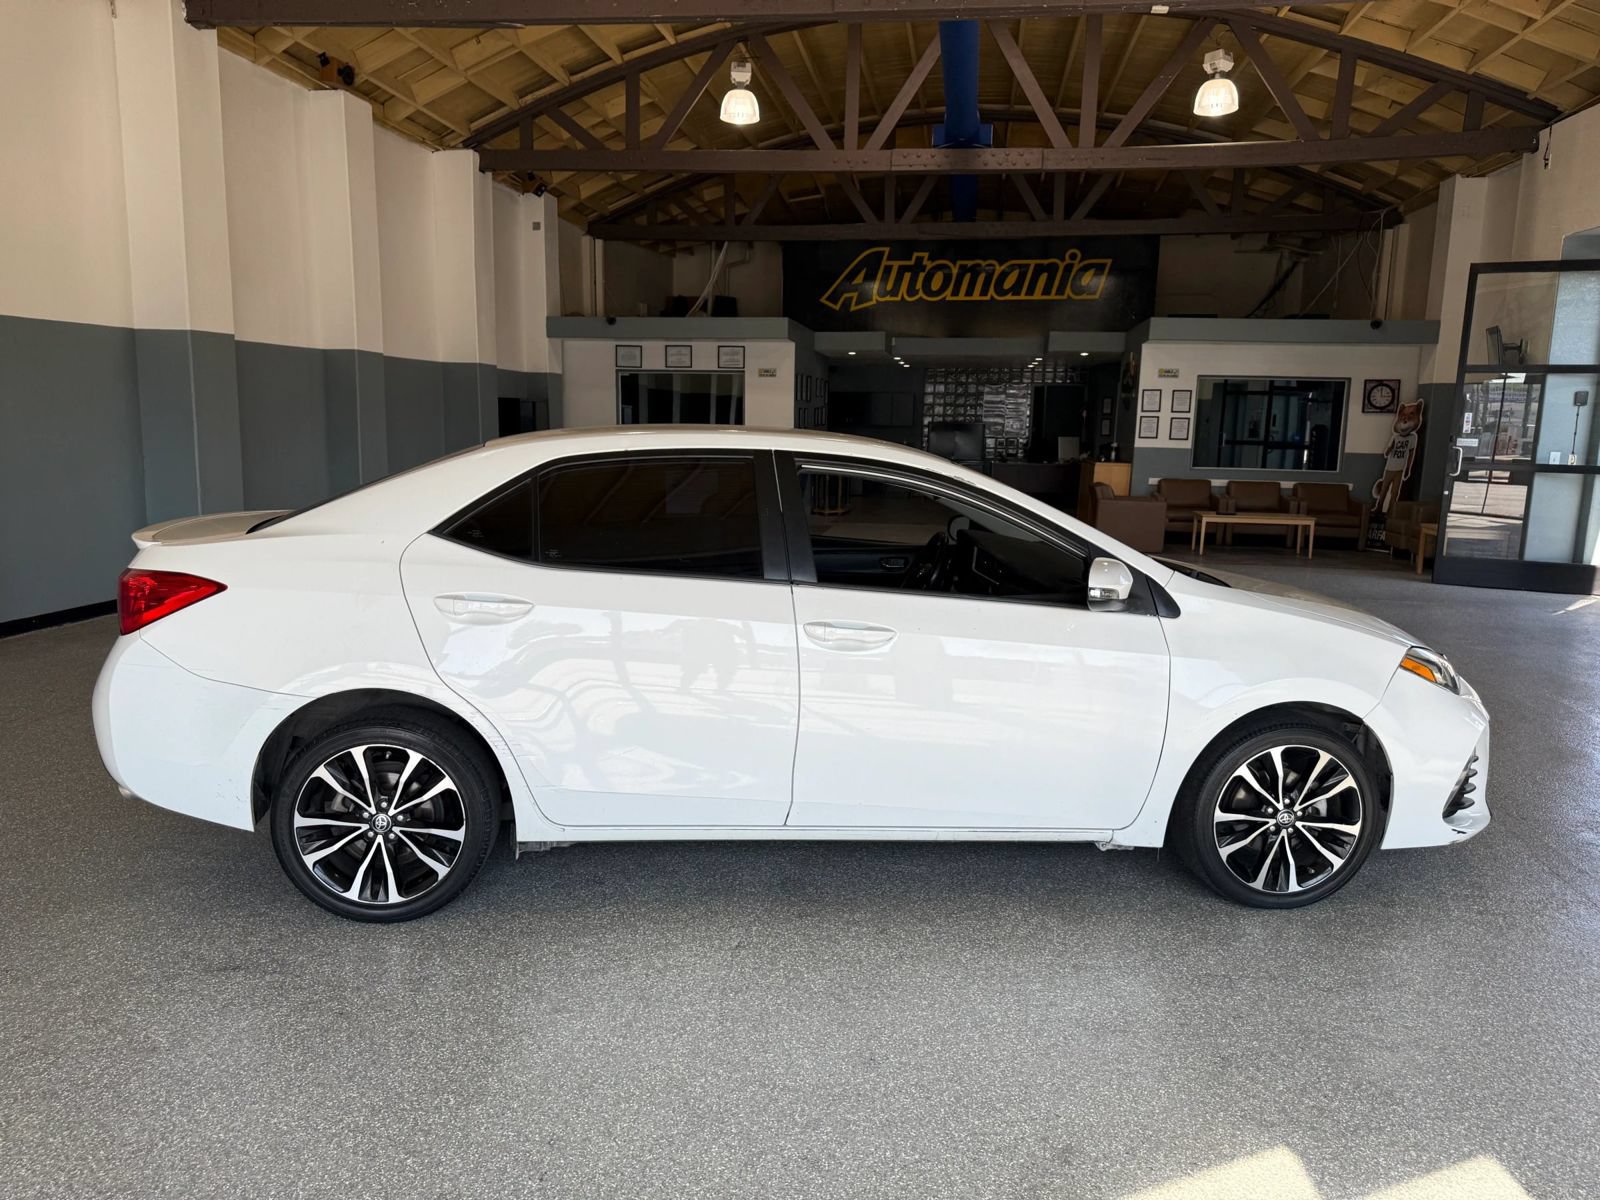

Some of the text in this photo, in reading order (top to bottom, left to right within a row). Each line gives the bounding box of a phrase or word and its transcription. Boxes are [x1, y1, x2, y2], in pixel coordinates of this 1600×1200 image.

[820, 247, 1112, 311] Automania
[1396, 440, 1409, 449] CAR
[1393, 449, 1406, 459] FOX
